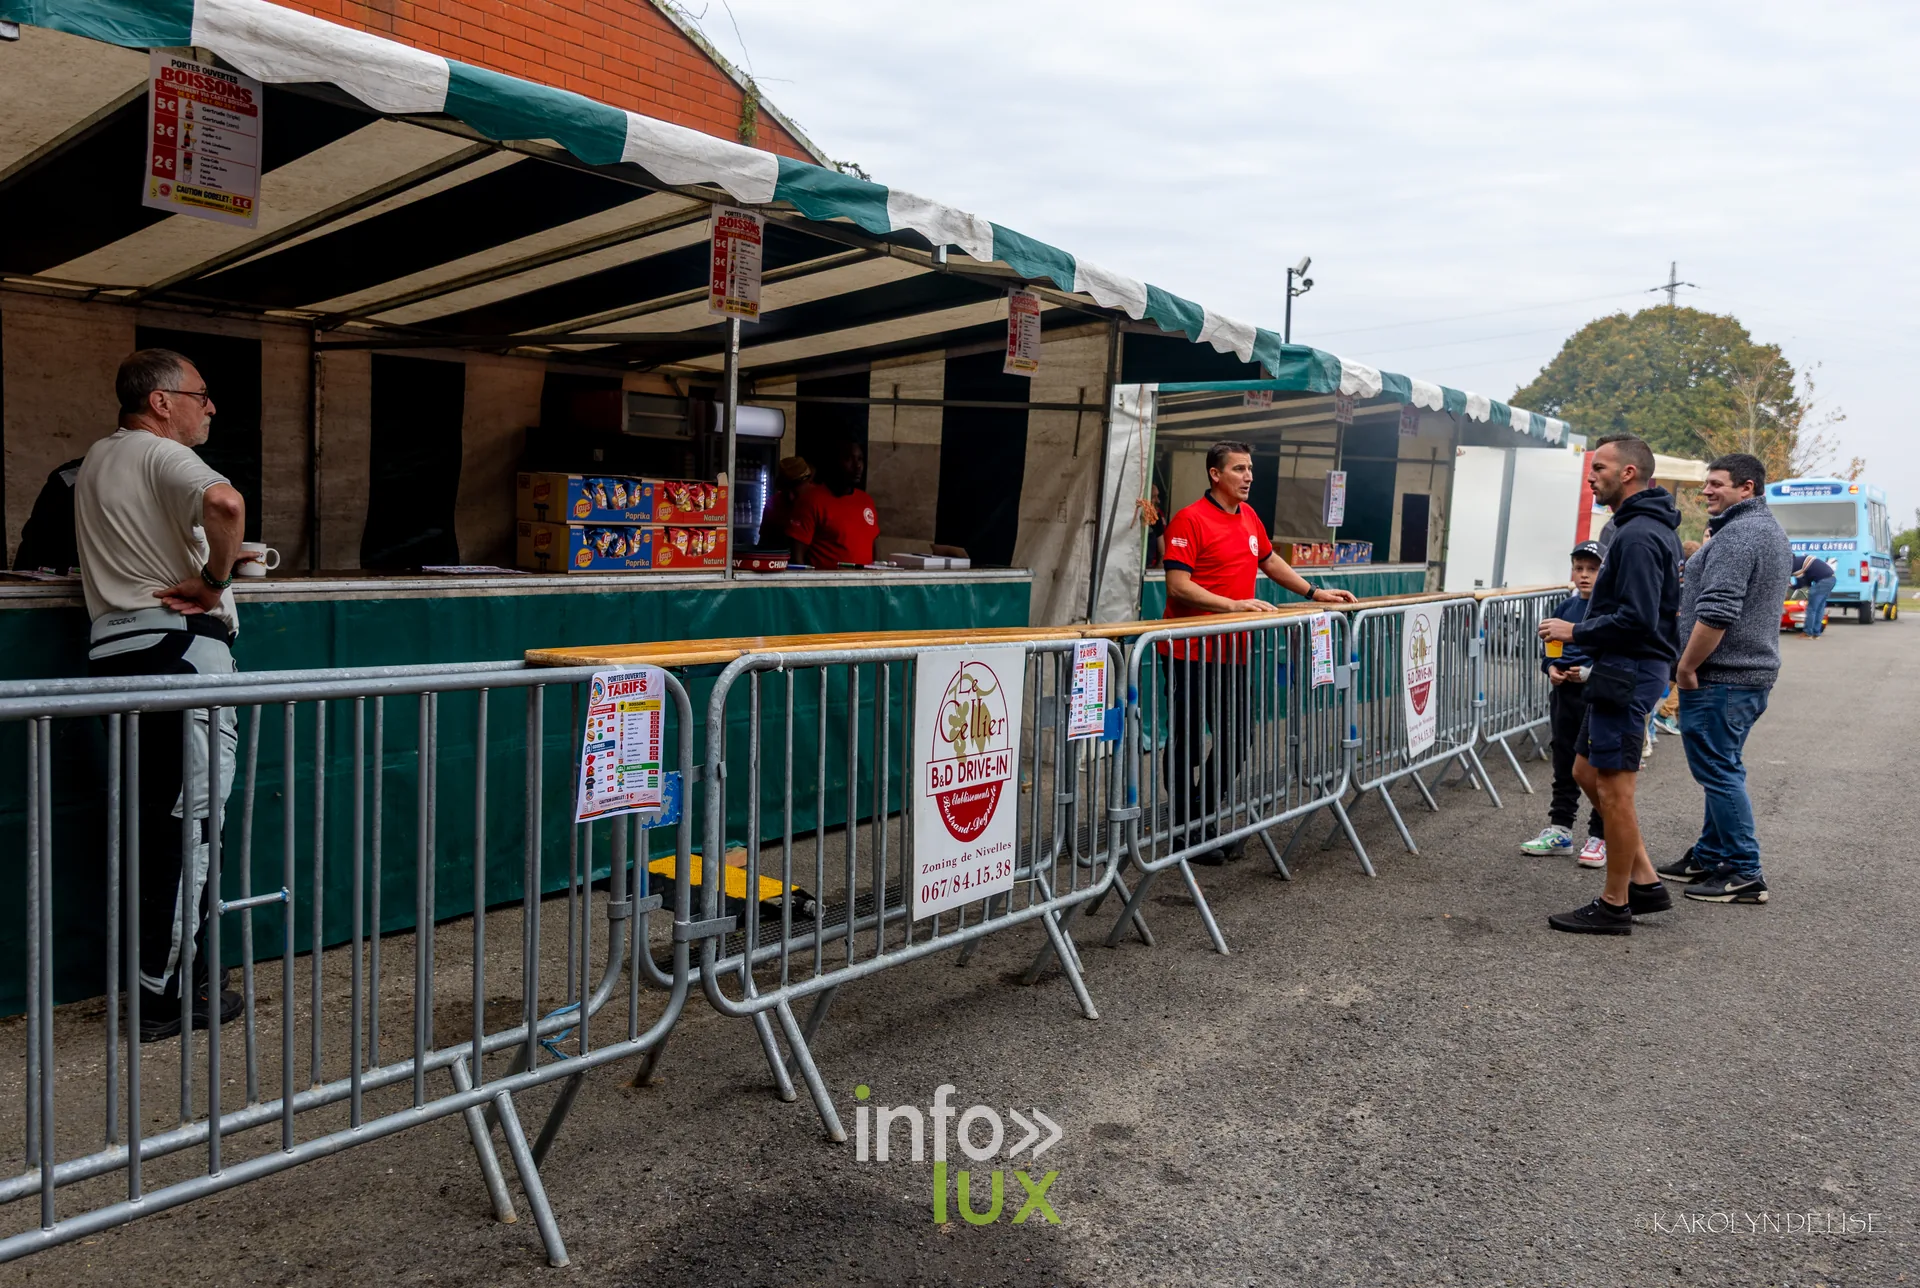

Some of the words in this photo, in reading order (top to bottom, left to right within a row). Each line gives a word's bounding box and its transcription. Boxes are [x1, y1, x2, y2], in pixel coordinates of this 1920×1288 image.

[171, 59, 200, 73] PORTES
[202, 67, 238, 84] OUVERTES
[161, 66, 253, 105] BOISSONS
[176, 185, 203, 197] CAUTION
[718, 216, 760, 236] BOISSONS
[625, 512, 651, 521] Paprika
[625, 558, 650, 567] Paprika
[1080, 648, 1097, 658] TARIFS
[607, 674, 624, 683] PORTES
[624, 672, 646, 680] OUVERTES
[607, 680, 647, 697] TARIFS
[958, 661, 978, 696] Le
[940, 698, 1005, 743] Cellier
[932, 764, 953, 789] B&D
[958, 754, 1007, 783] DRIVE-IN
[922, 857, 957, 874] Zoning
[961, 852, 972, 862] de
[976, 842, 1012, 858] Nivelles
[922, 859, 1011, 904] 067/84.15.38
